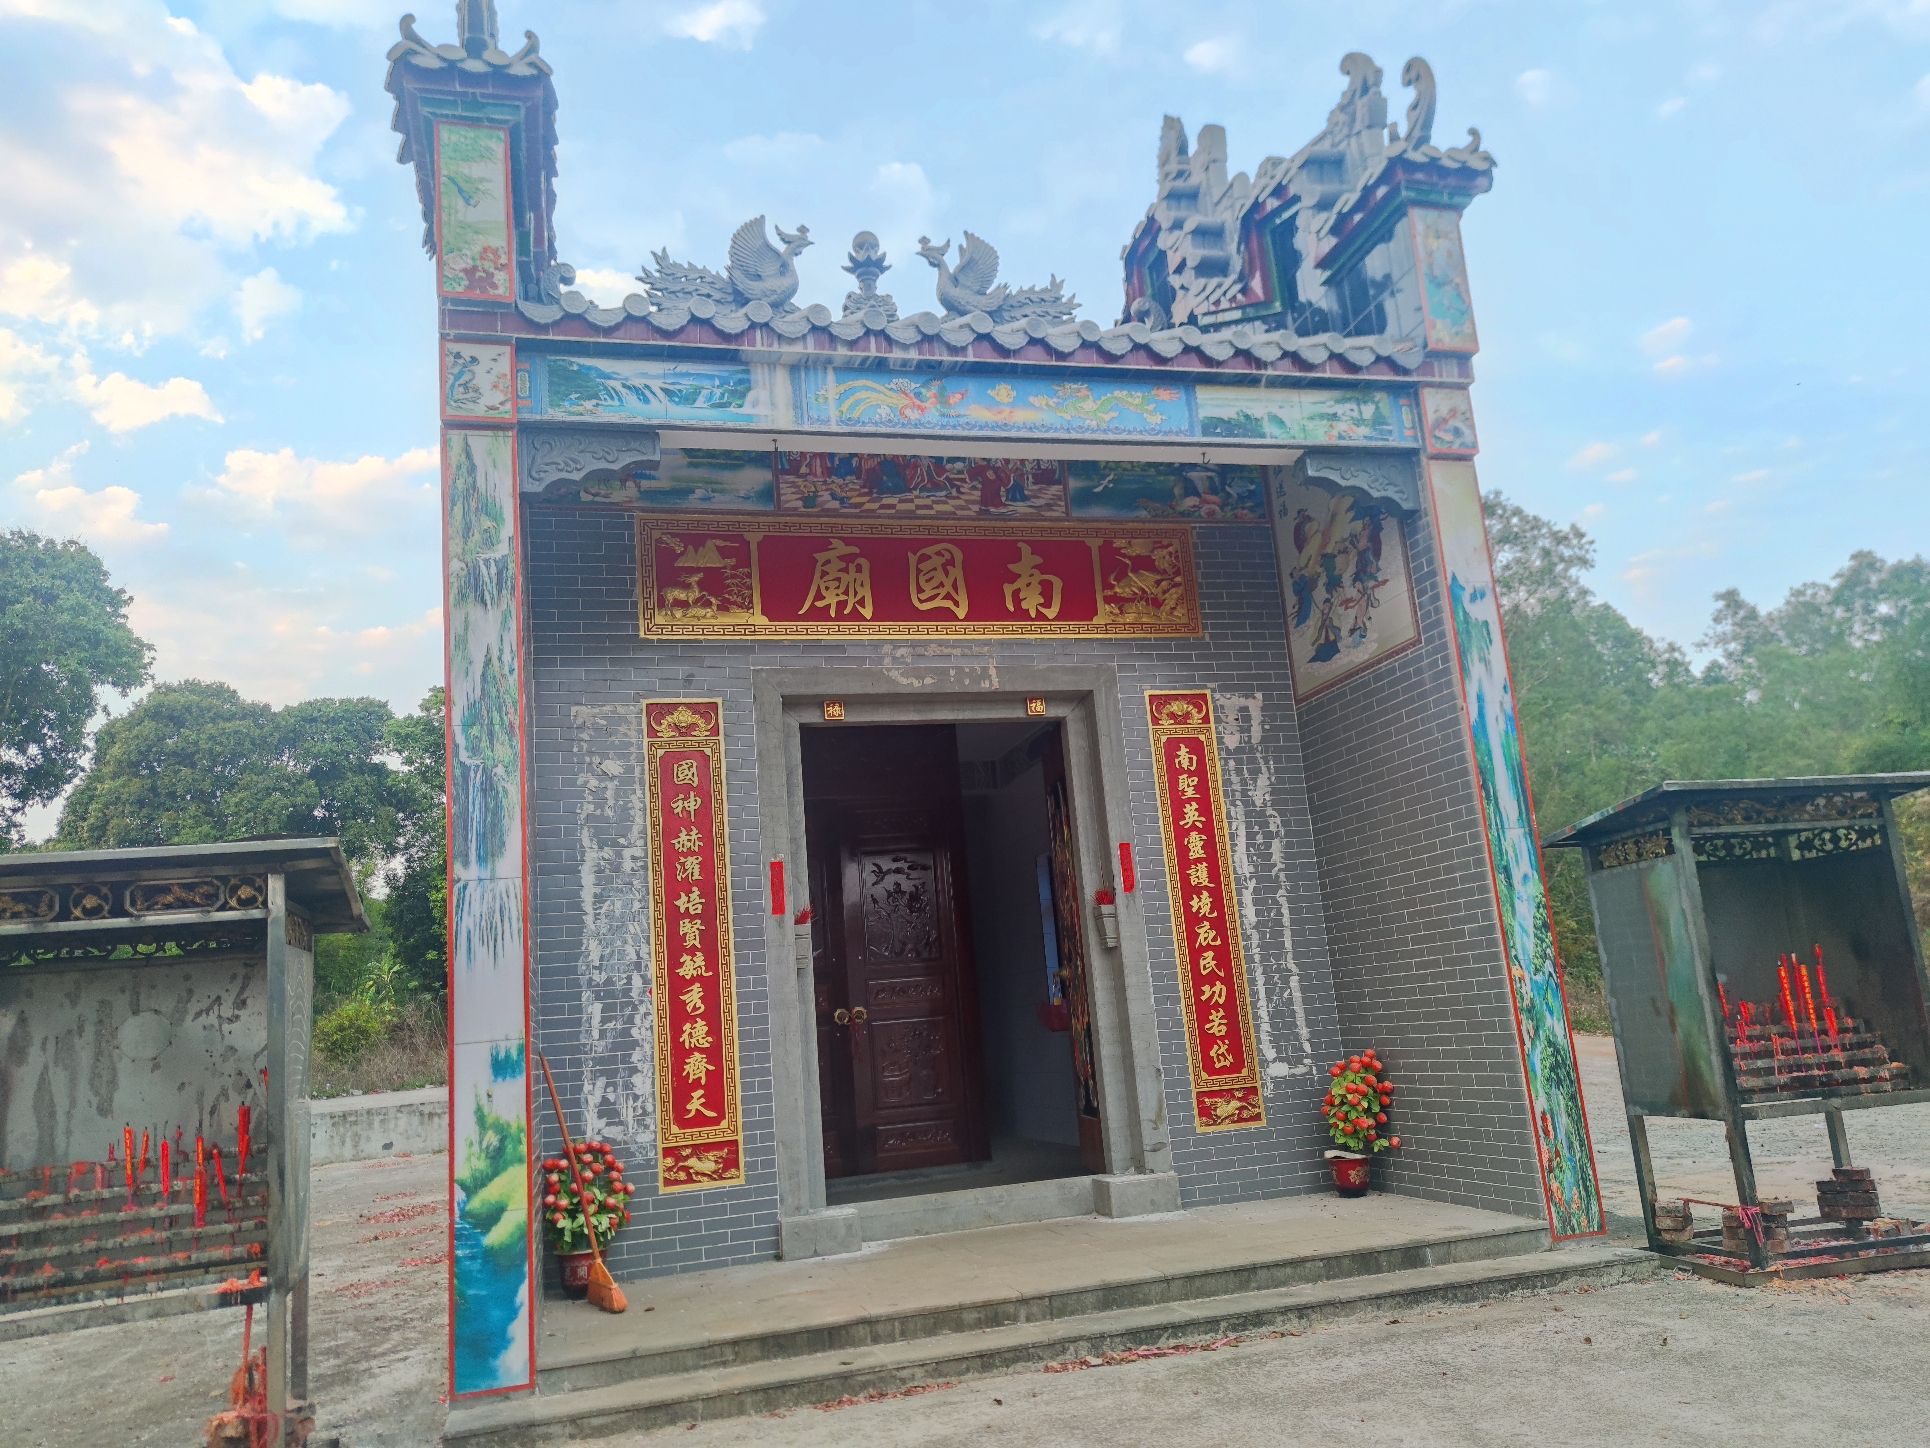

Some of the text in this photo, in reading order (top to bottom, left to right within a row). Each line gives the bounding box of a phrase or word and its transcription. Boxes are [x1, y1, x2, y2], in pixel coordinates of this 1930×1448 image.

[798, 538, 1063, 620] 南國廟
[1029, 699, 1044, 713] 福
